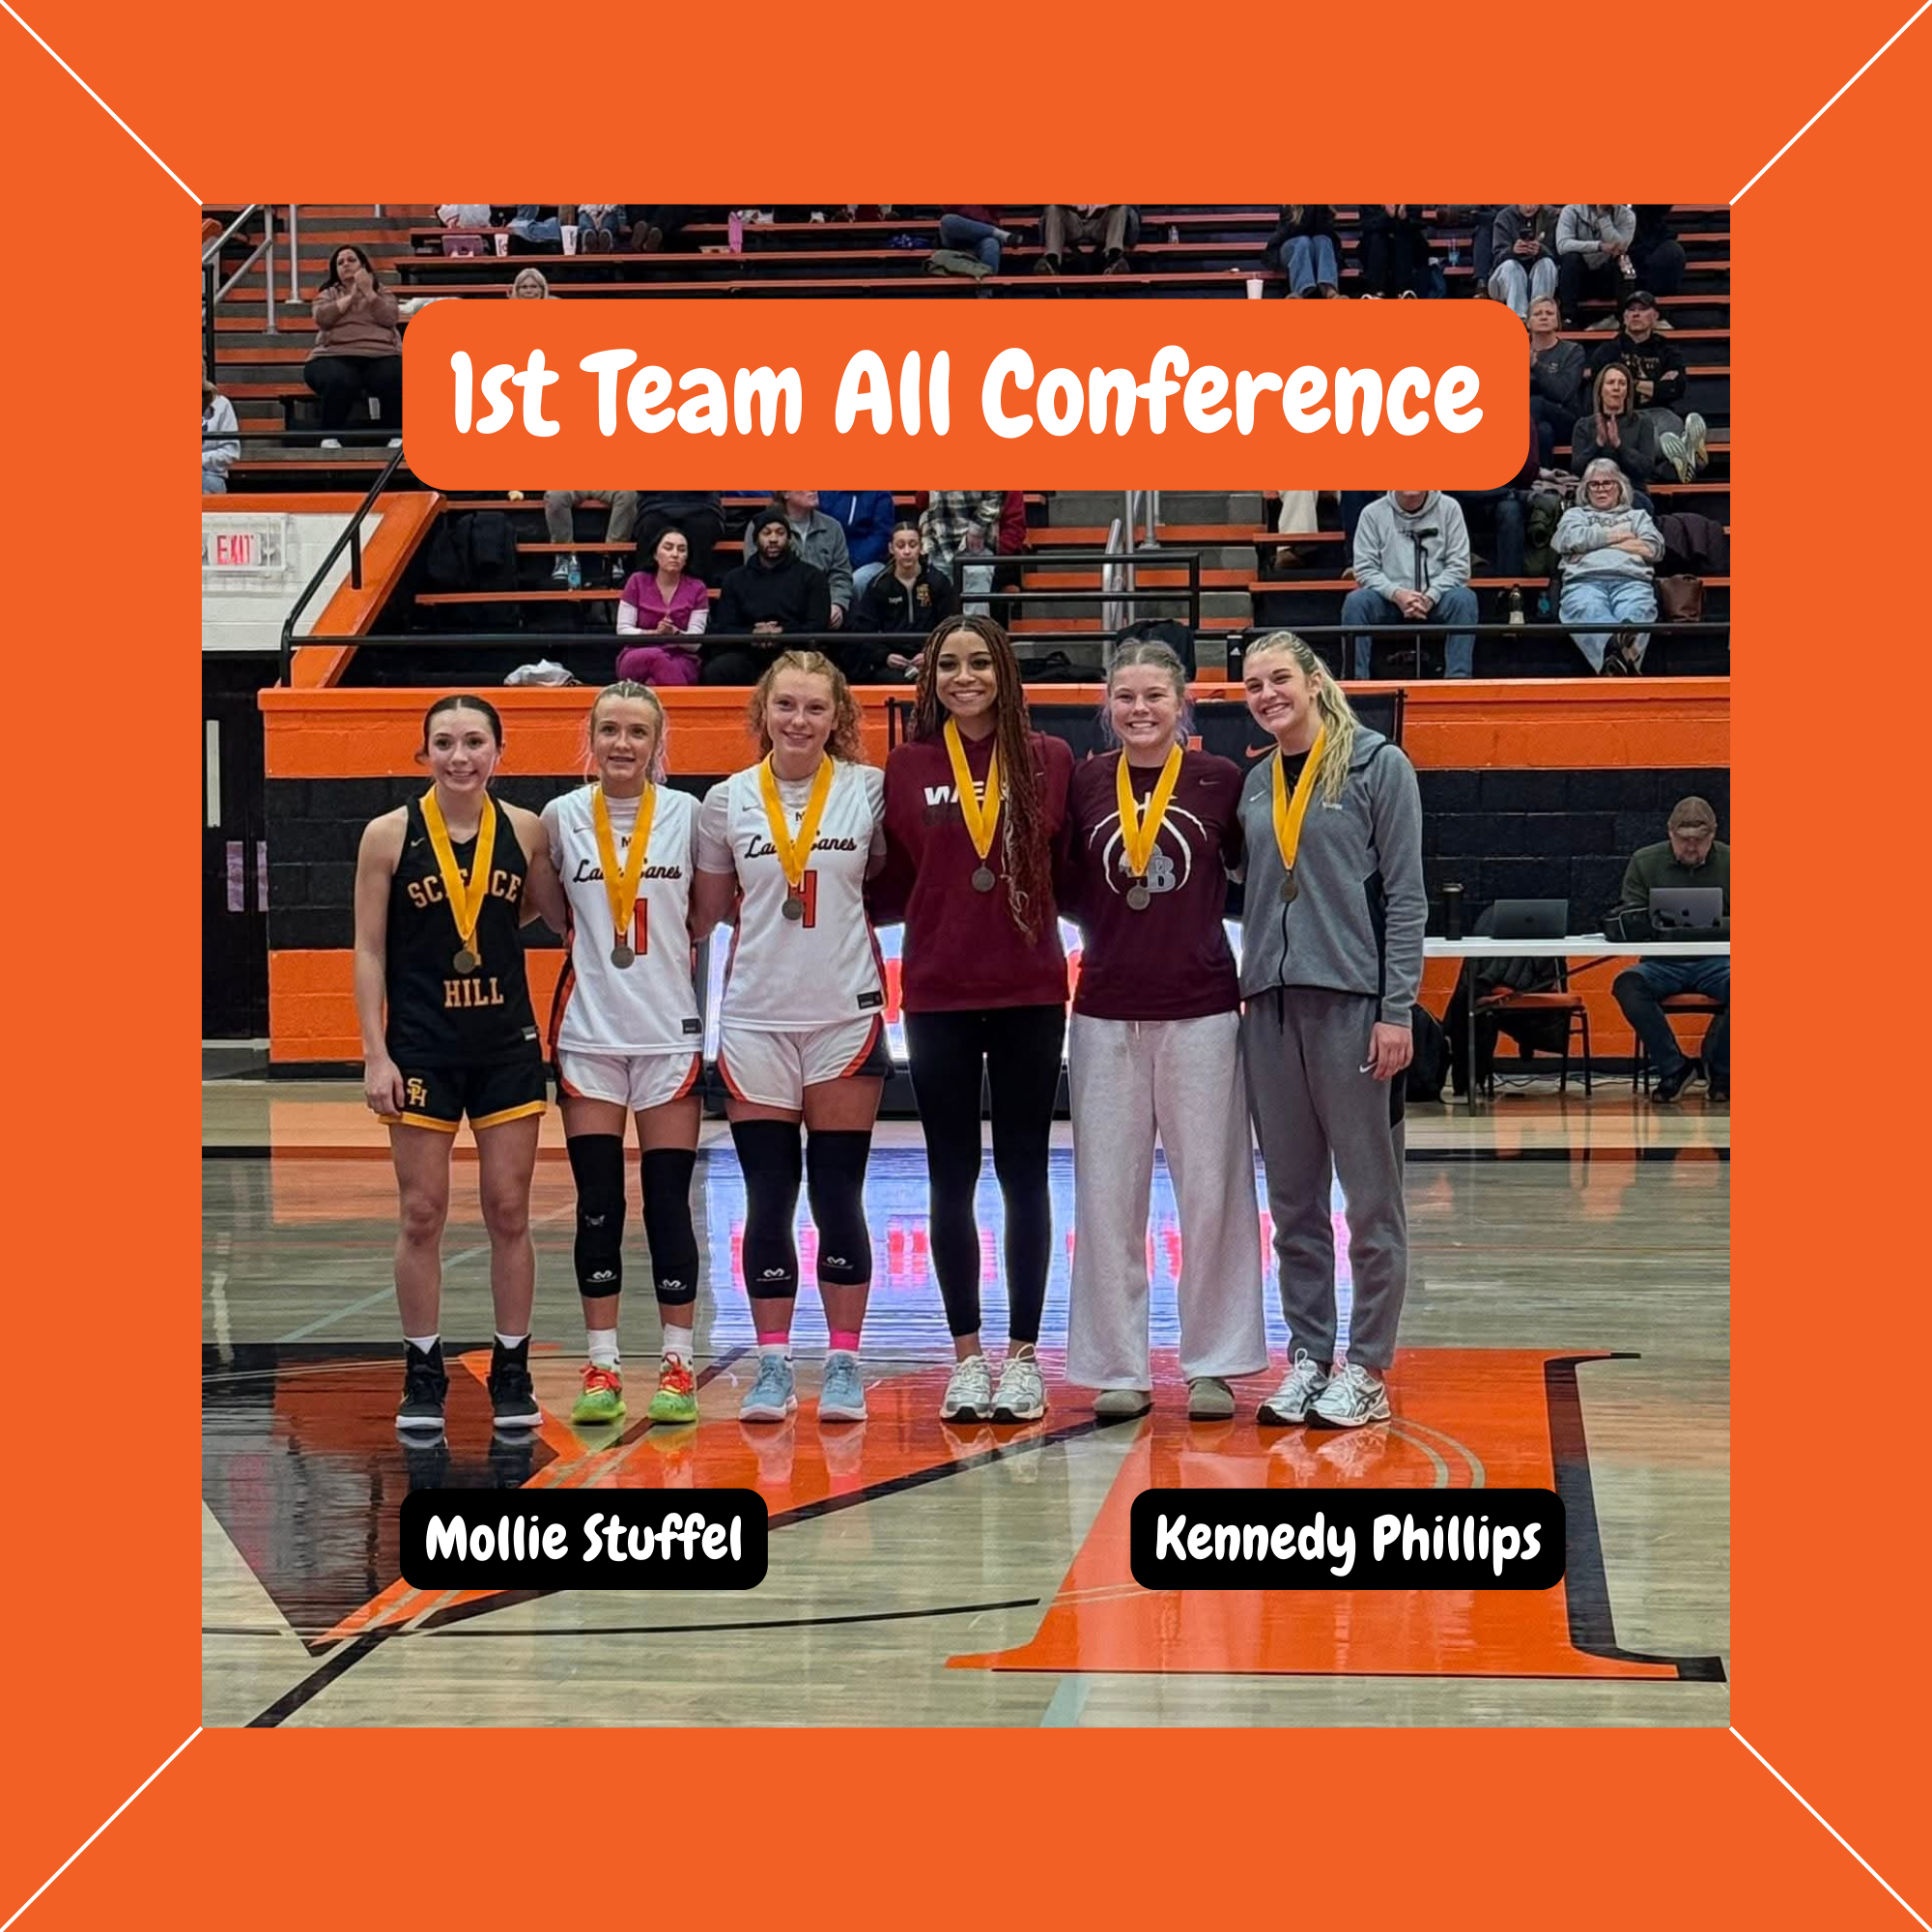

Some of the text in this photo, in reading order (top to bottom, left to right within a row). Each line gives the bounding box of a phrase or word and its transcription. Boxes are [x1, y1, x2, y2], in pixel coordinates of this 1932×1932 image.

[216, 534, 254, 565] EXIT
[408, 867, 522, 908] SCCE
[442, 978, 505, 1009] HILL
